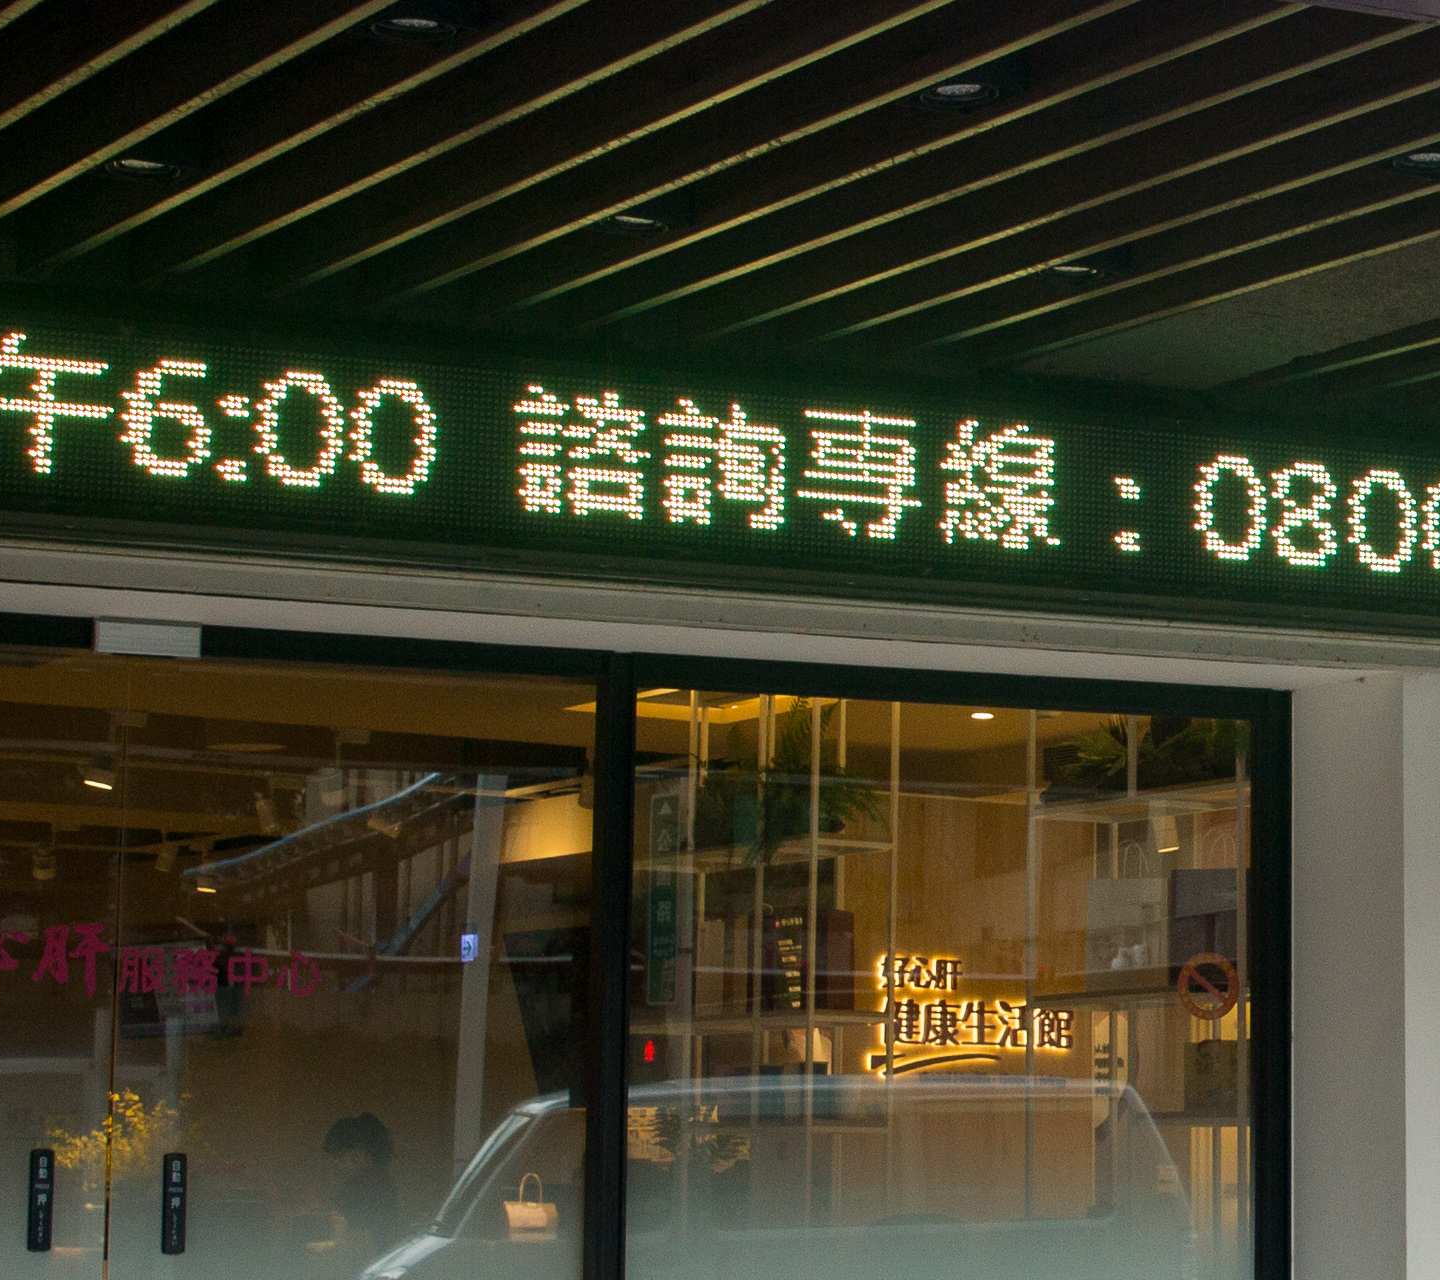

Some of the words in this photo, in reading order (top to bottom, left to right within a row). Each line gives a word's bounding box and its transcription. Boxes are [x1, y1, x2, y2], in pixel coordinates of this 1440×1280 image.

[119, 945, 324, 998] 服務中心
[878, 955, 963, 991] 好心肝
[880, 999, 1075, 1051] 健康生活館
